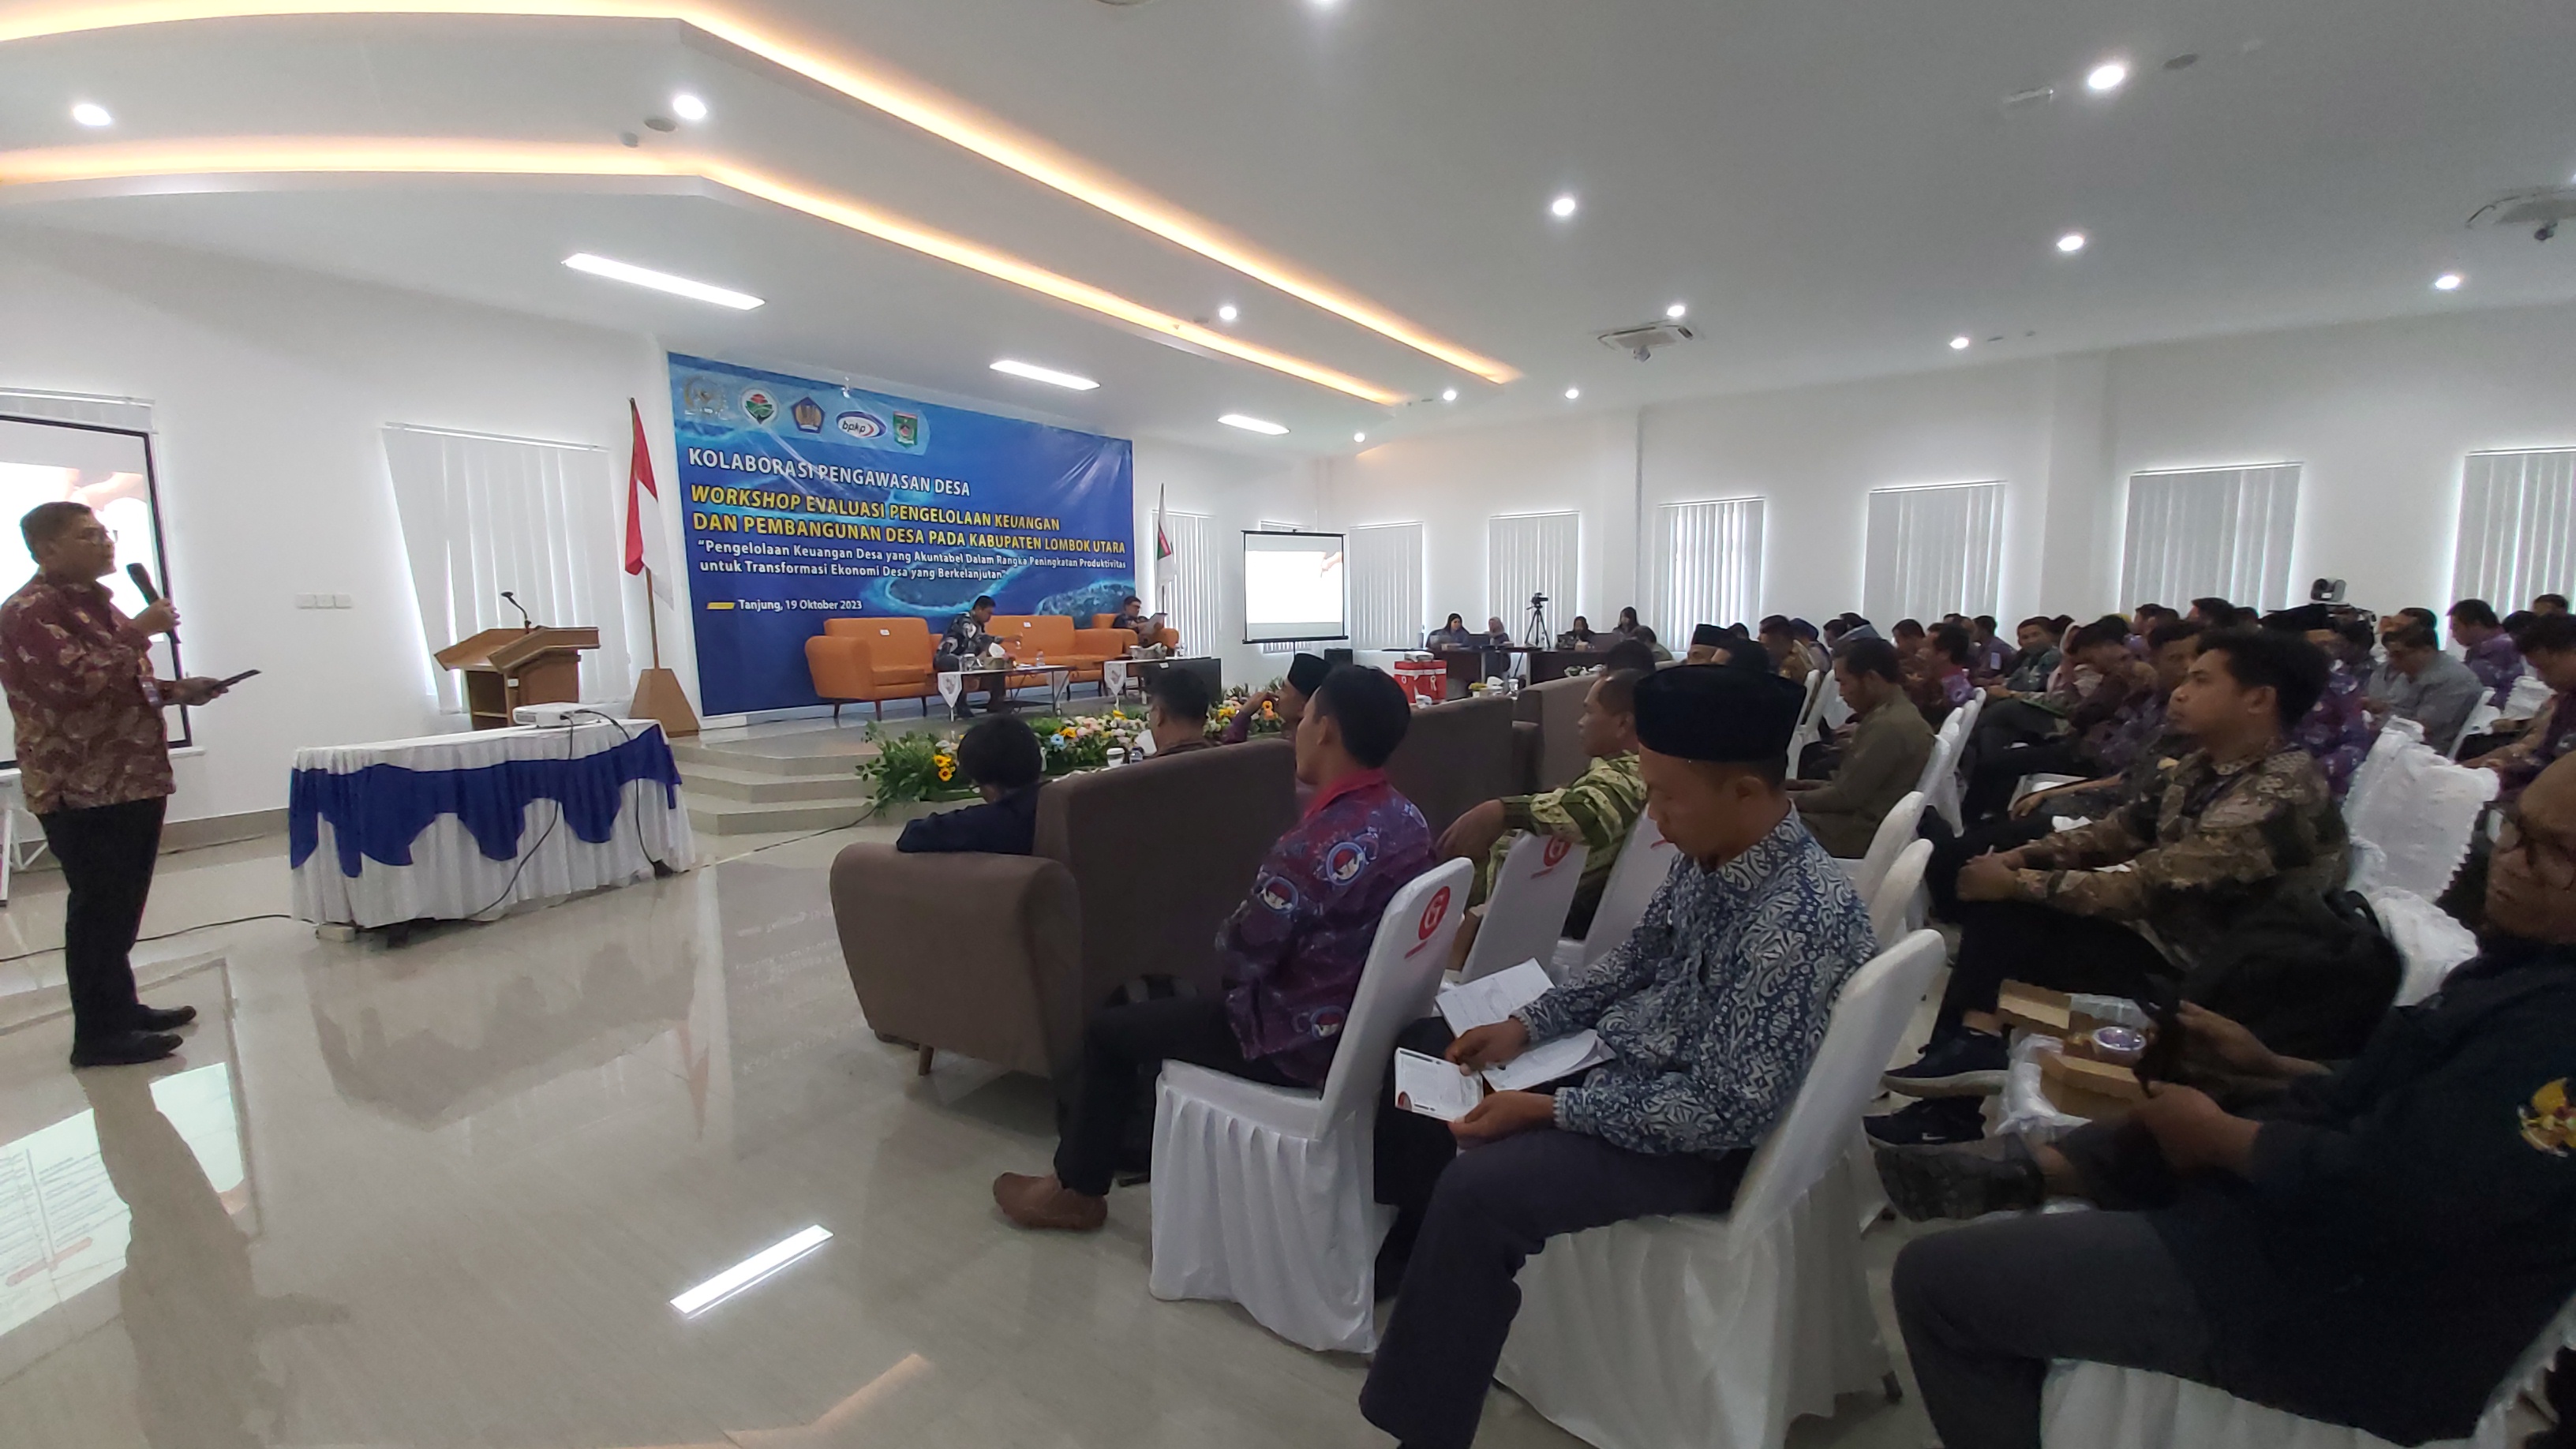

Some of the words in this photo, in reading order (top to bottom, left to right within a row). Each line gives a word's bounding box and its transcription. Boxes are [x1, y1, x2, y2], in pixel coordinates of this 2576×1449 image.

[842, 420, 866, 434] bpkp
[688, 447, 814, 479] KOLABORASI
[818, 464, 930, 492] PENGAWASAN
[934, 478, 971, 496] DESA
[691, 484, 801, 511] WORKSHOP
[806, 496, 885, 519] EVALUASI
[889, 504, 991, 526] PENGELOLAAN
[994, 513, 1060, 531] KEUANGAN
[693, 512, 738, 532] DAN
[743, 516, 882, 541] PEMBANGUNAN
[886, 527, 924, 545] DESA
[929, 530, 965, 546] PADA
[969, 533, 1042, 550] KABUPATEN
[1044, 538, 1090, 552] LOMBOK
[1093, 541, 1125, 554] UTARA
[793, 545, 853, 561] Keuangan
[856, 548, 883, 561] Desa
[886, 552, 911, 564] yang
[914, 551, 964, 564] Akuntabel
[966, 553, 994, 565] Dalam
[996, 555, 1028, 567] Rangka
[1030, 556, 1078, 568] Peningkatan
[1080, 559, 1126, 569] Produktivitas
[700, 560, 743, 573] untuk
[744, 560, 828, 575] Transformasi
[831, 564, 880, 577] Ekonomi
[882, 565, 908, 578] Desa
[911, 569, 935, 580] yang
[738, 599, 783, 612] Tanjung,
[785, 600, 797, 610] 19
[799, 599, 838, 610] Oktober
[840, 600, 863, 610] 2023
